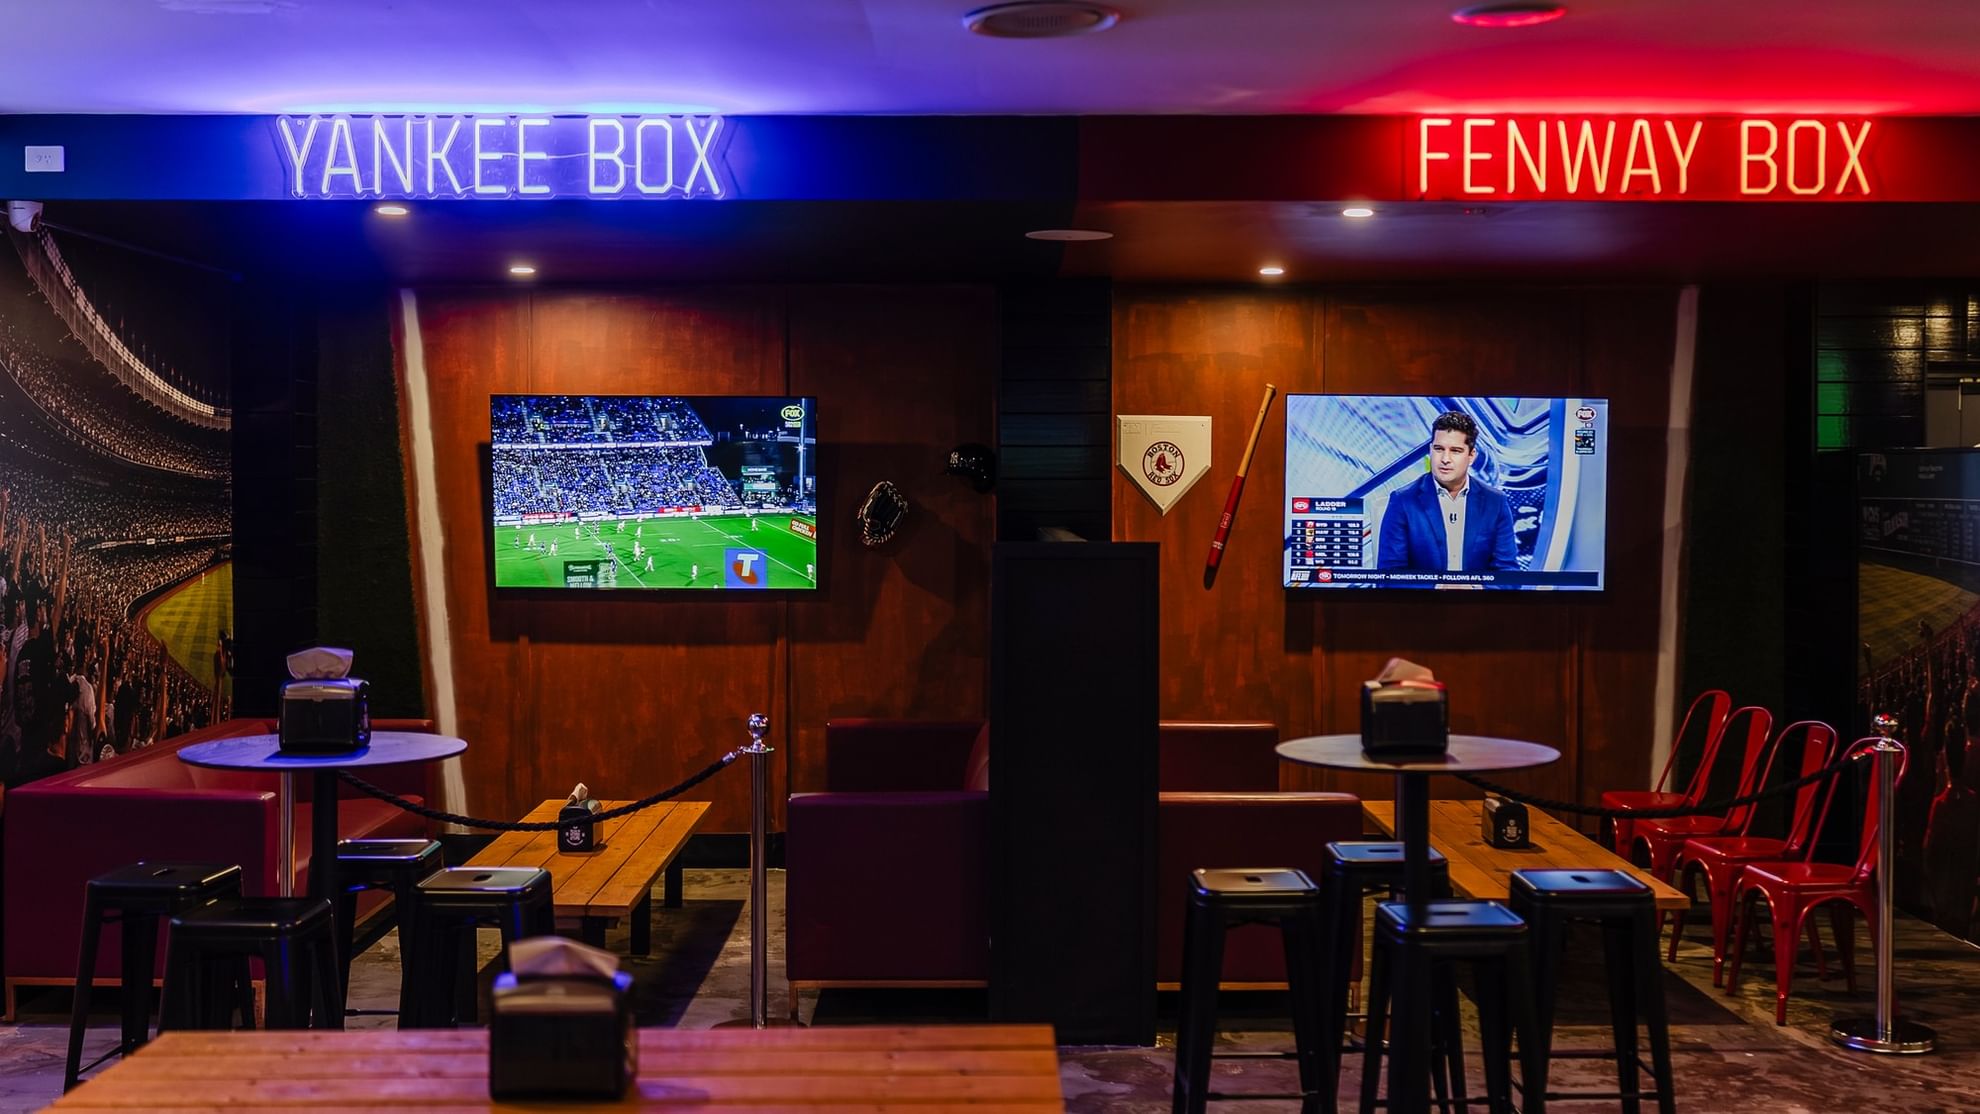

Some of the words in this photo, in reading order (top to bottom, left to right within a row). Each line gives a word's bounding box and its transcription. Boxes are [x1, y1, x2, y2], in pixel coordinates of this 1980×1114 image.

[279, 118, 551, 195] YANKEE
[588, 118, 720, 195] BOX
[1419, 118, 1703, 195] FENWAY
[1740, 118, 1872, 196] BOX
[785, 409, 801, 418] FOX
[1147, 444, 1181, 458] BOSTON
[1147, 471, 1162, 483] RED
[1165, 471, 1179, 484] SOX
[737, 553, 759, 577] T
[566, 575, 589, 583] SMOOTH
